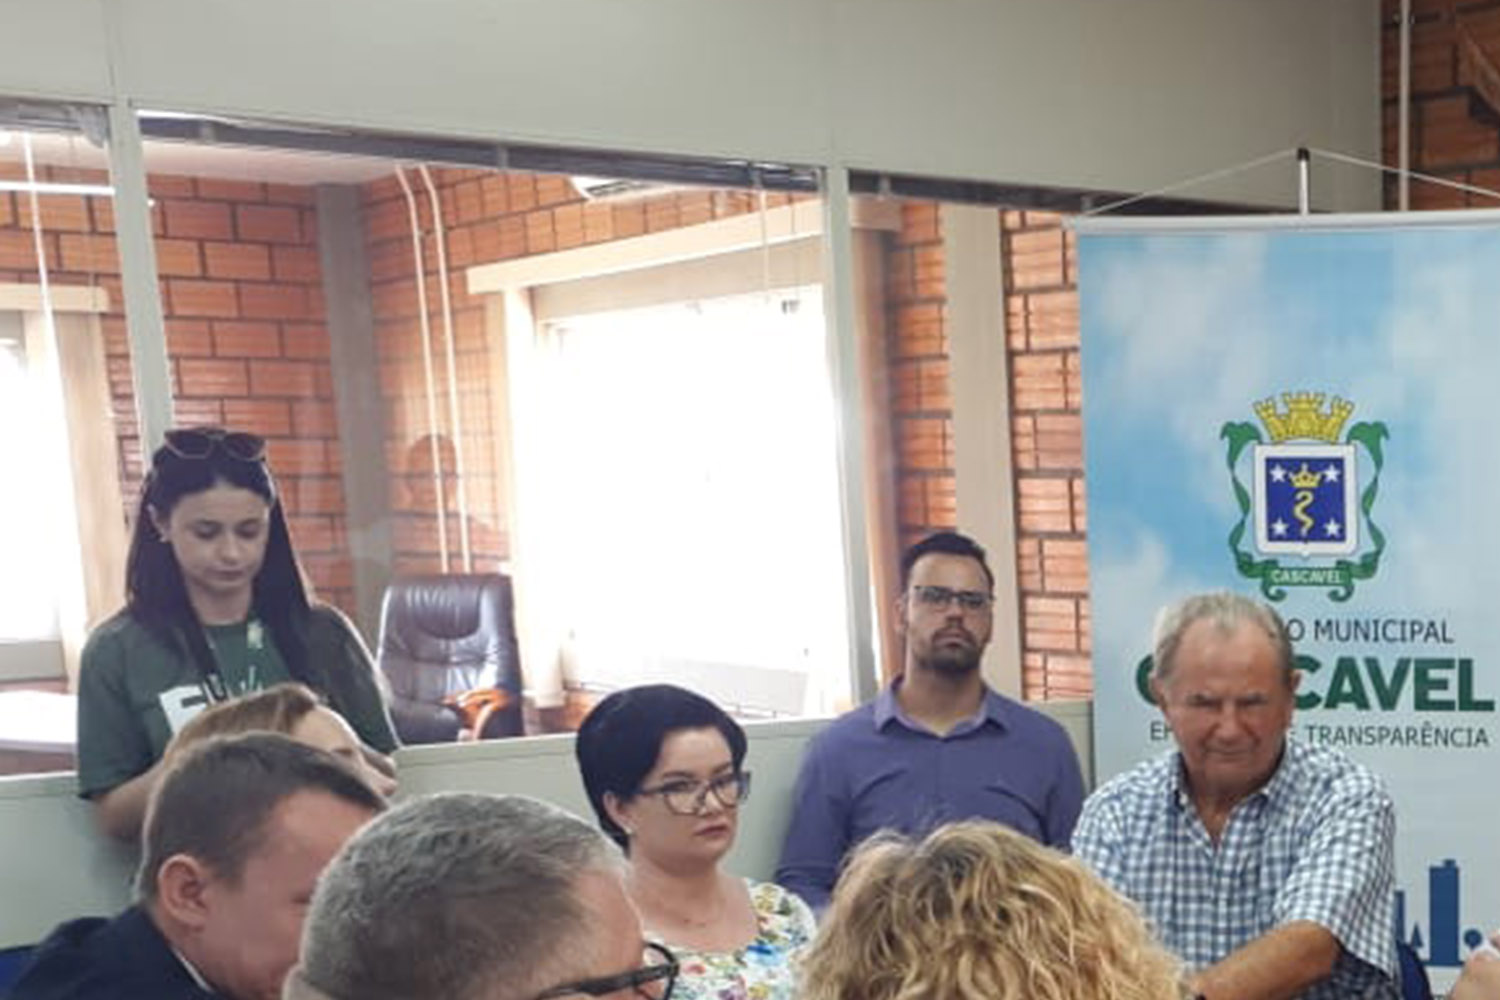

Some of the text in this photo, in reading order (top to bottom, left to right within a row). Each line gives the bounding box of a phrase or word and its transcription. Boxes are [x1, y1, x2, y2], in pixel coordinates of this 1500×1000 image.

[1270, 569, 1343, 585] CASCAVEL
[1314, 618, 1455, 644] MUNICIPAL
[1135, 654, 1496, 712] CCAVEL
[1304, 721, 1490, 747] TRANSPARÊNCIA
